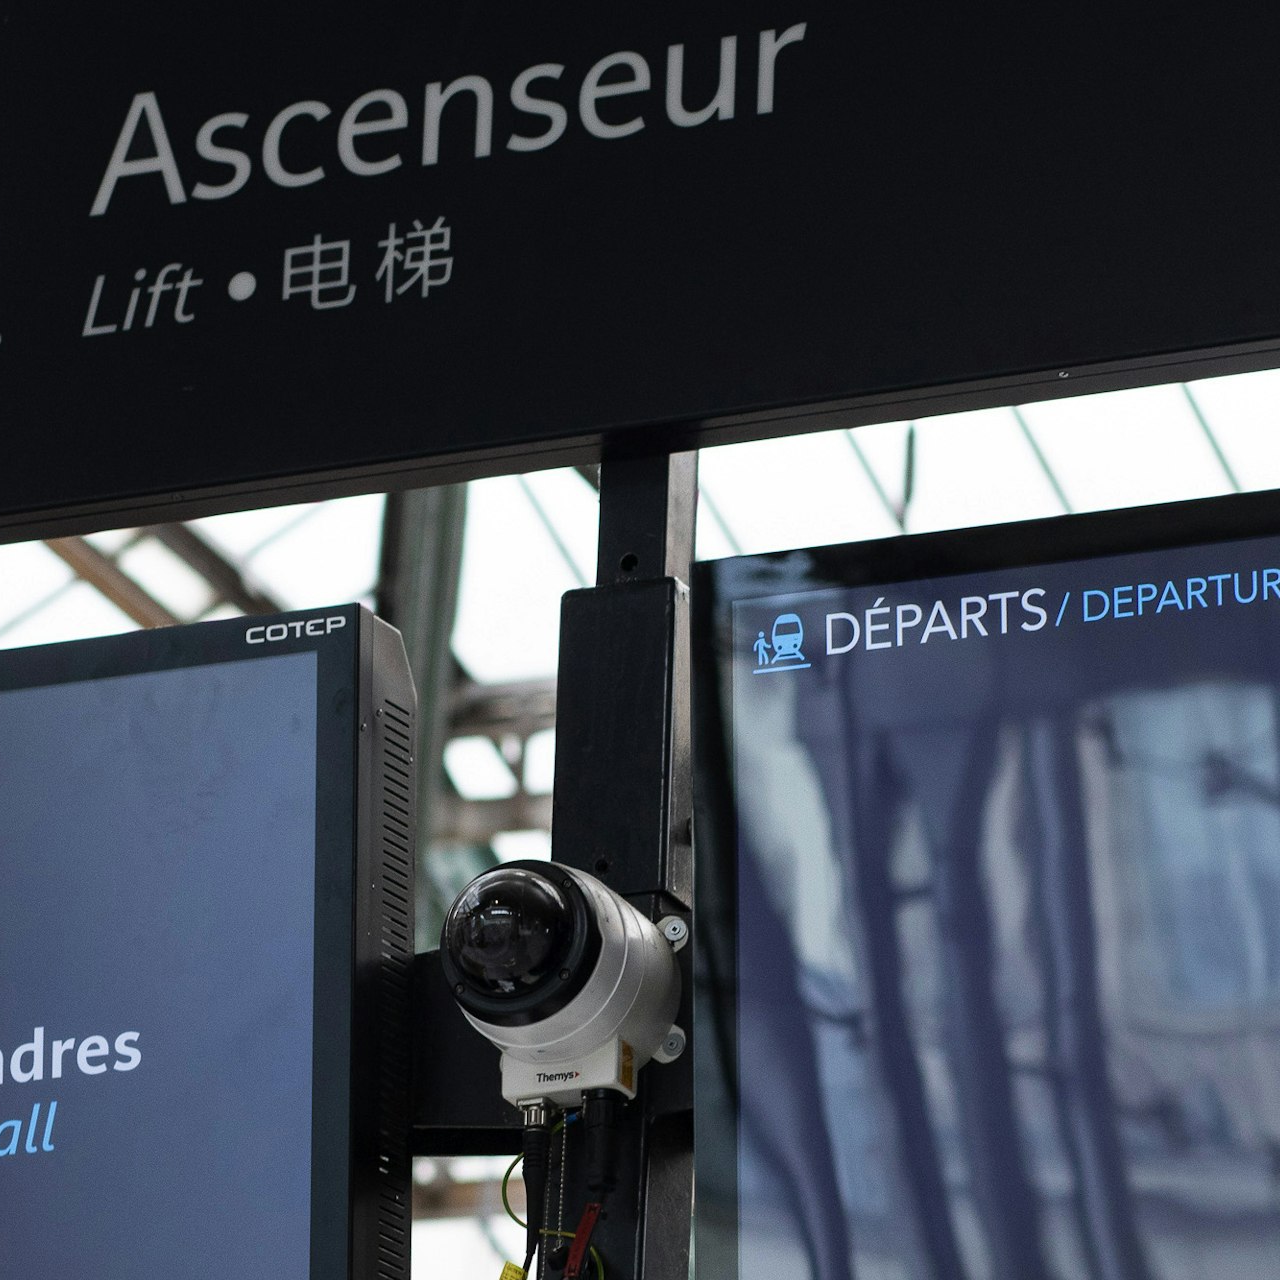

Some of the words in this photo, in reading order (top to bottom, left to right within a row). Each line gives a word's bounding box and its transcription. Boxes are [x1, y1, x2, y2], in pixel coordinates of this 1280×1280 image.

[89, 22, 807, 216] Ascenseur
[82, 263, 204, 337] Lift
[282, 216, 454, 310] 电梯
[245, 615, 346, 644] COTEP
[825, 587, 1047, 656] DÉPARTS
[536, 1071, 575, 1083] Themys
